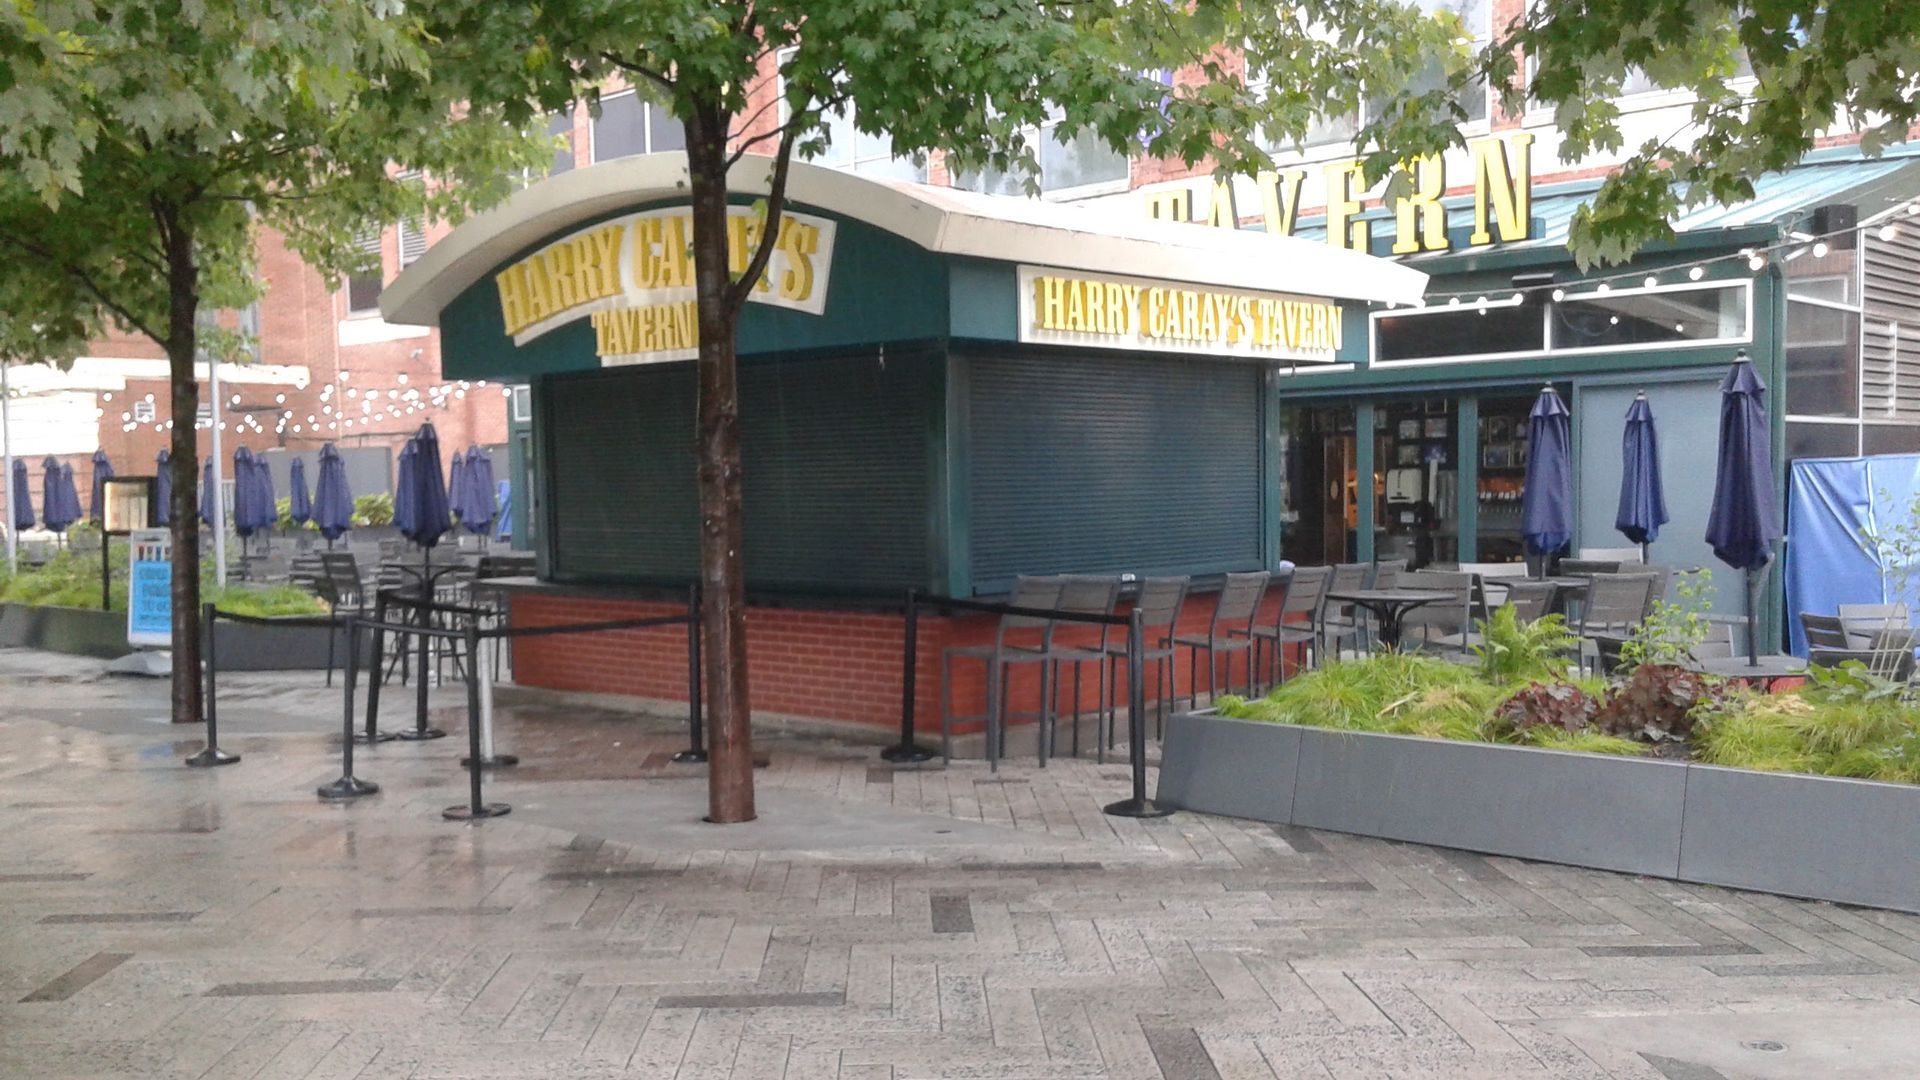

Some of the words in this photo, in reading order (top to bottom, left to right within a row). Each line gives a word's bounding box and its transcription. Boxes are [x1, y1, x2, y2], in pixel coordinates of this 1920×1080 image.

[496, 224, 626, 336] HARRY
[632, 215, 819, 302] CA'S
[592, 301, 698, 357] TAVERN
[1034, 276, 1140, 336] HARRY
[1141, 287, 1253, 344] CARAY'S
[1256, 298, 1343, 351] TAVERN
